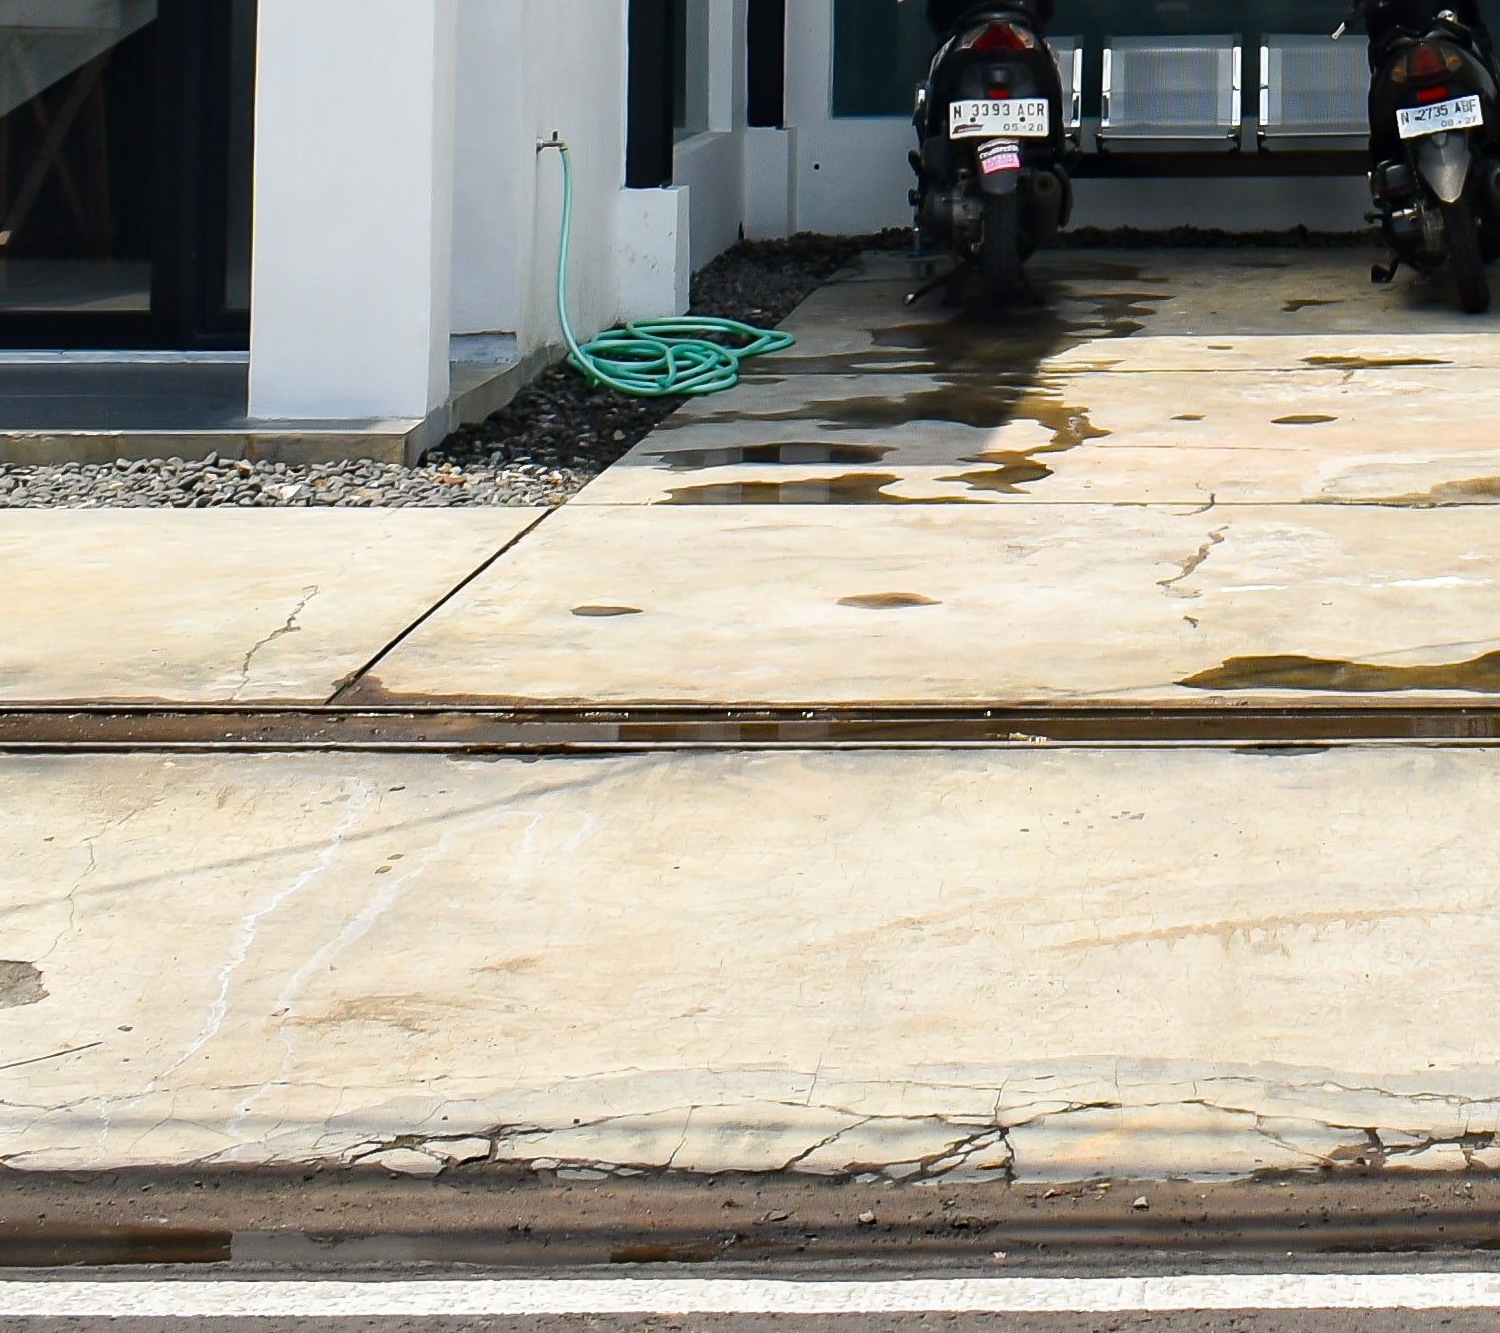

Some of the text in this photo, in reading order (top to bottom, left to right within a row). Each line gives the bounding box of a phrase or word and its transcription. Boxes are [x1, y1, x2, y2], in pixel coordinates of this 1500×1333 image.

[953, 103, 1045, 119] N 3393 ACR
[1401, 111, 1409, 125] N
[1455, 99, 1476, 113] ABF
